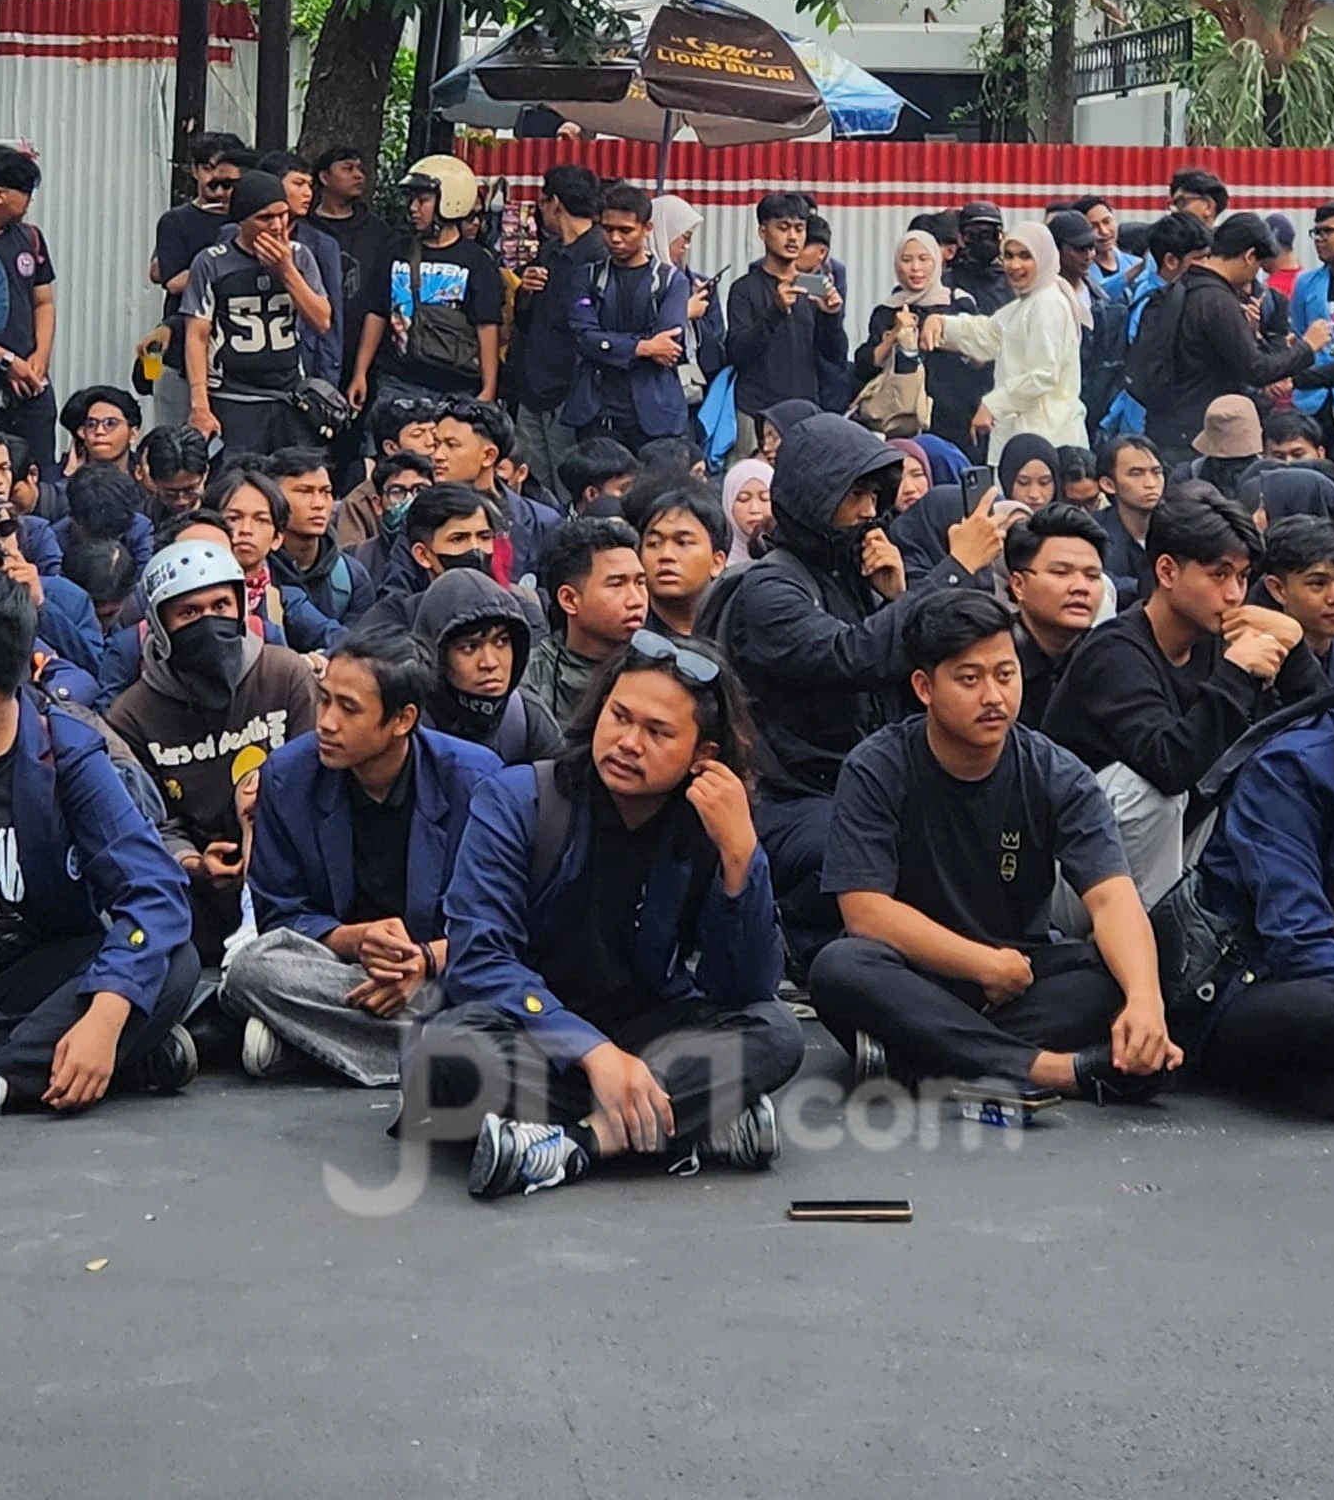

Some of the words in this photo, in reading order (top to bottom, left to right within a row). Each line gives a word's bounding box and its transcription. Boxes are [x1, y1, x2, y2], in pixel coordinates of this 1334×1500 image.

[656, 48, 722, 70] LIONG
[724, 62, 795, 81] BULAN
[227, 292, 296, 354] 52
